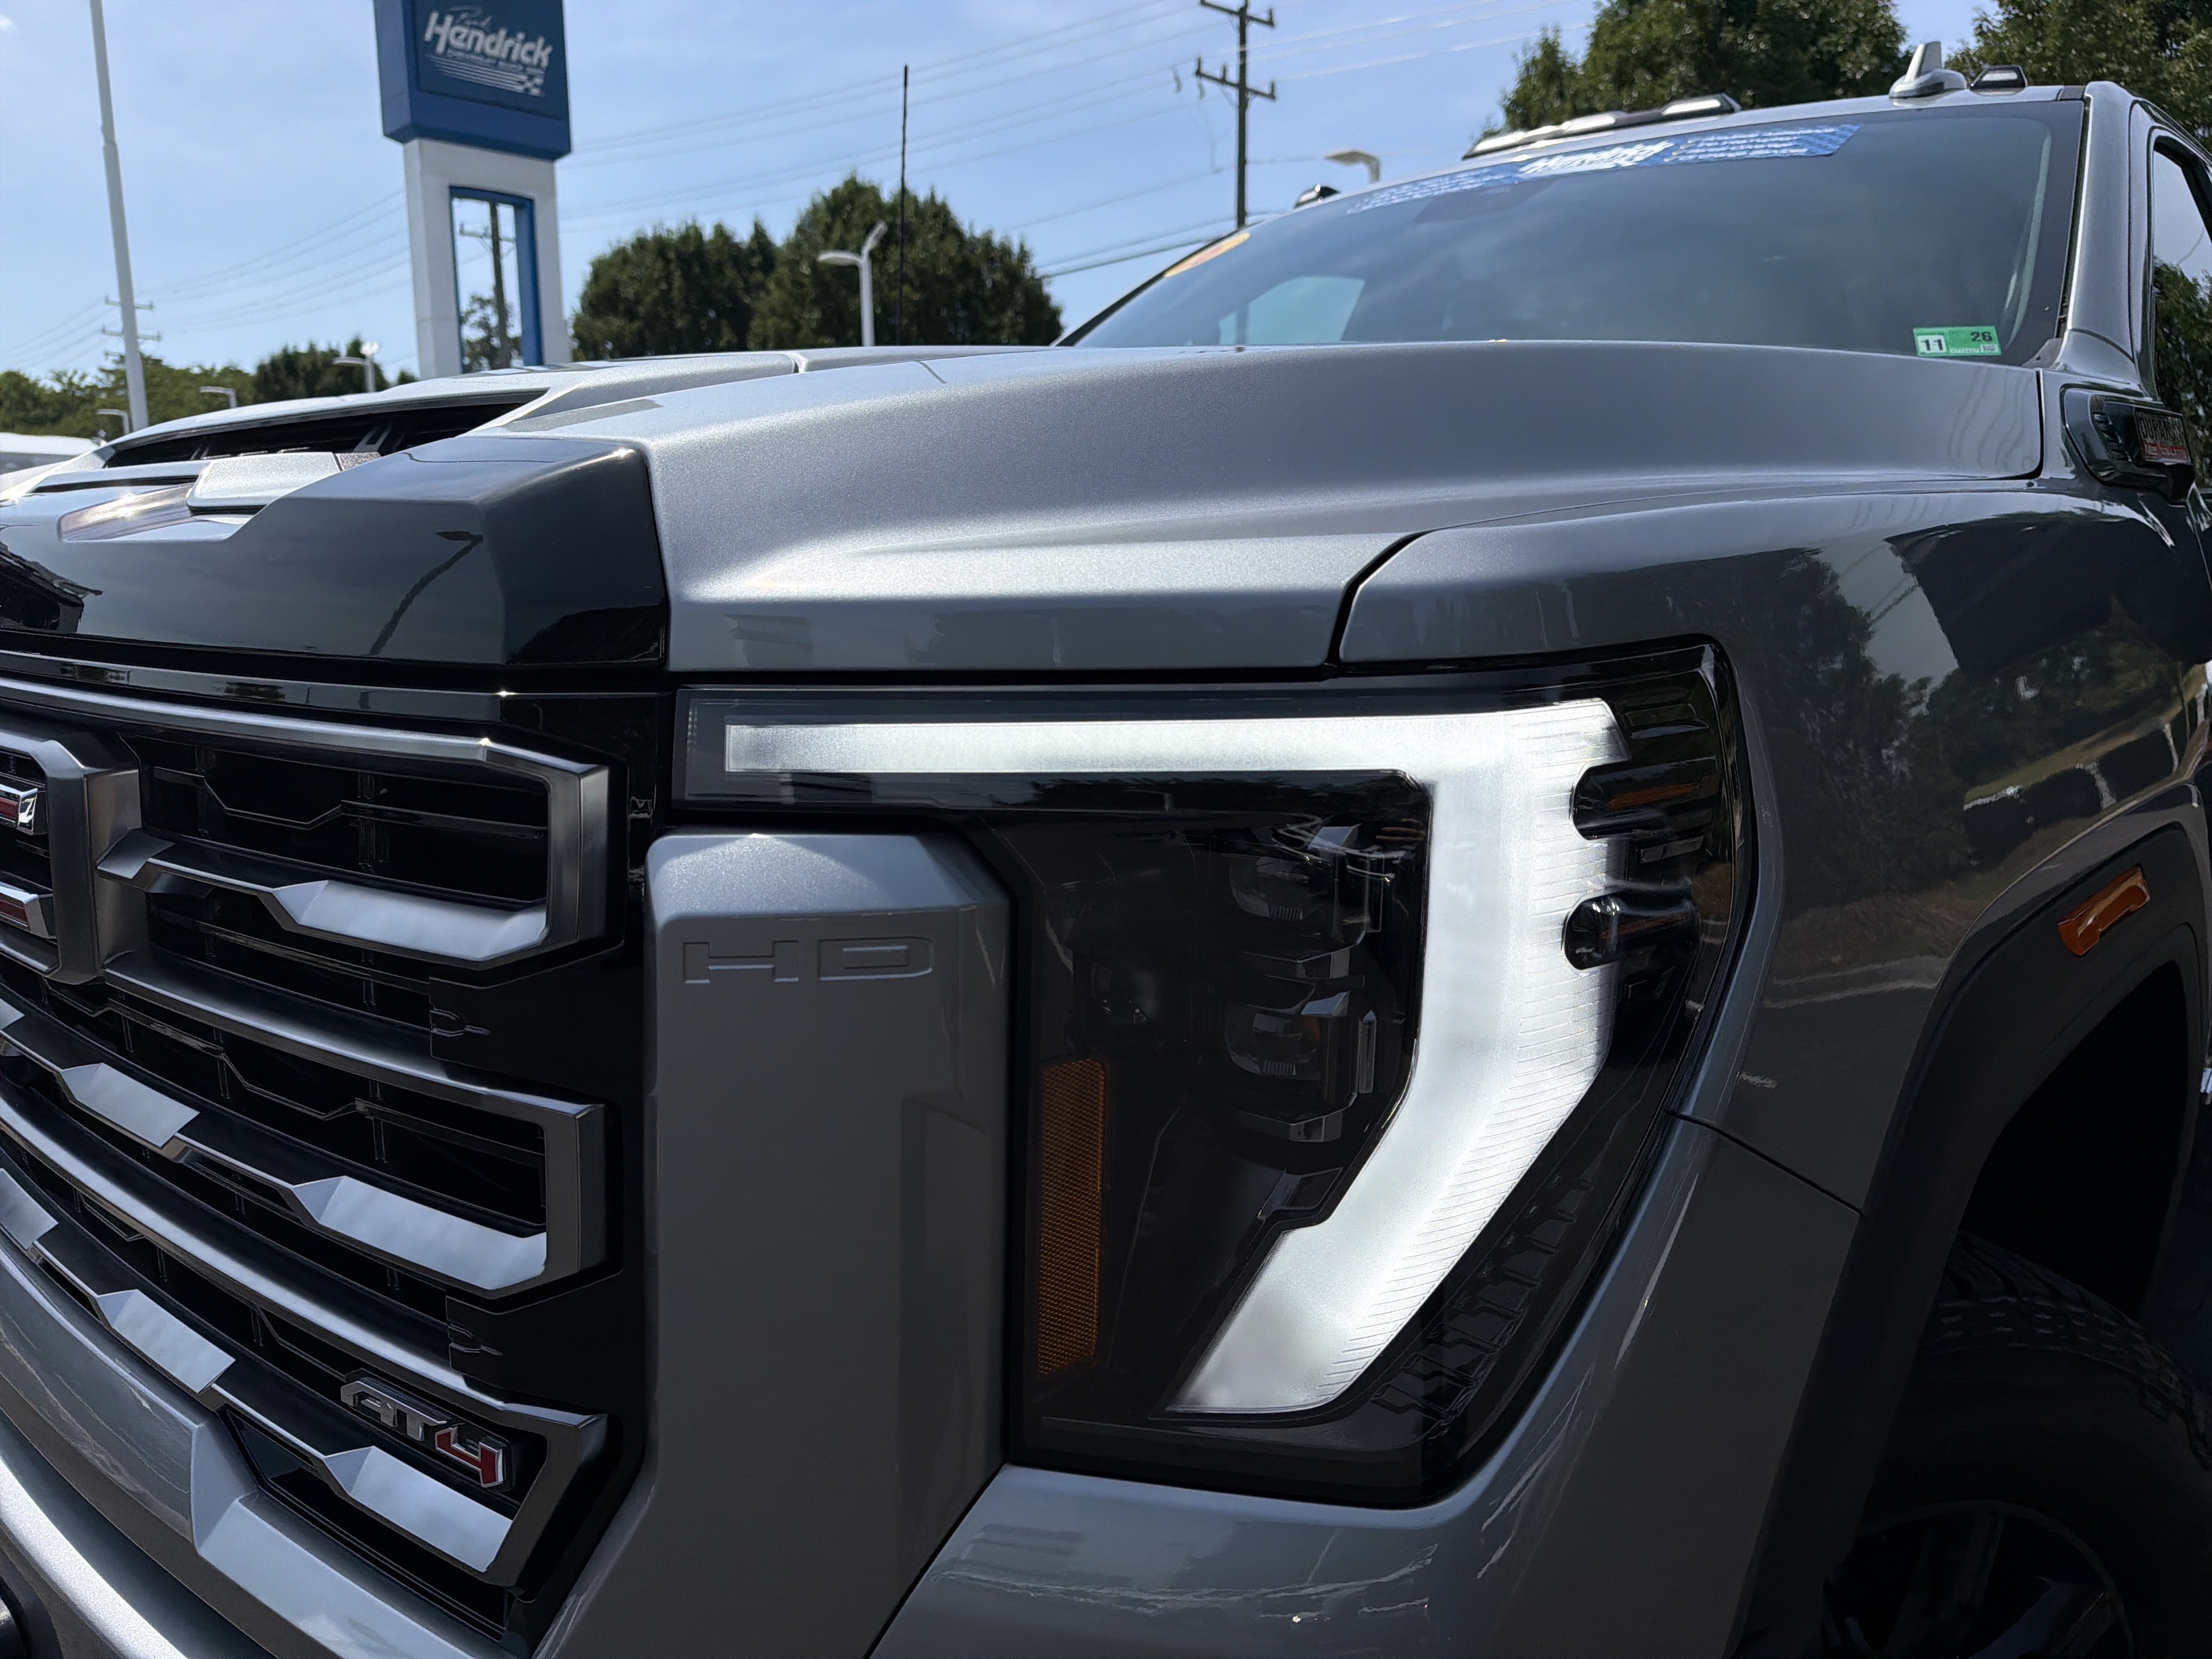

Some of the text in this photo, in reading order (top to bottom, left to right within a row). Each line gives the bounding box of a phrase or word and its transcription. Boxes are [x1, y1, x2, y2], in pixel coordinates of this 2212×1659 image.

[424, 10, 553, 68] Hendrick
[1921, 339, 1944, 352] 11
[1971, 331, 1993, 342] 26
[682, 936, 933, 984] HD
[340, 1380, 504, 1488] AT4
